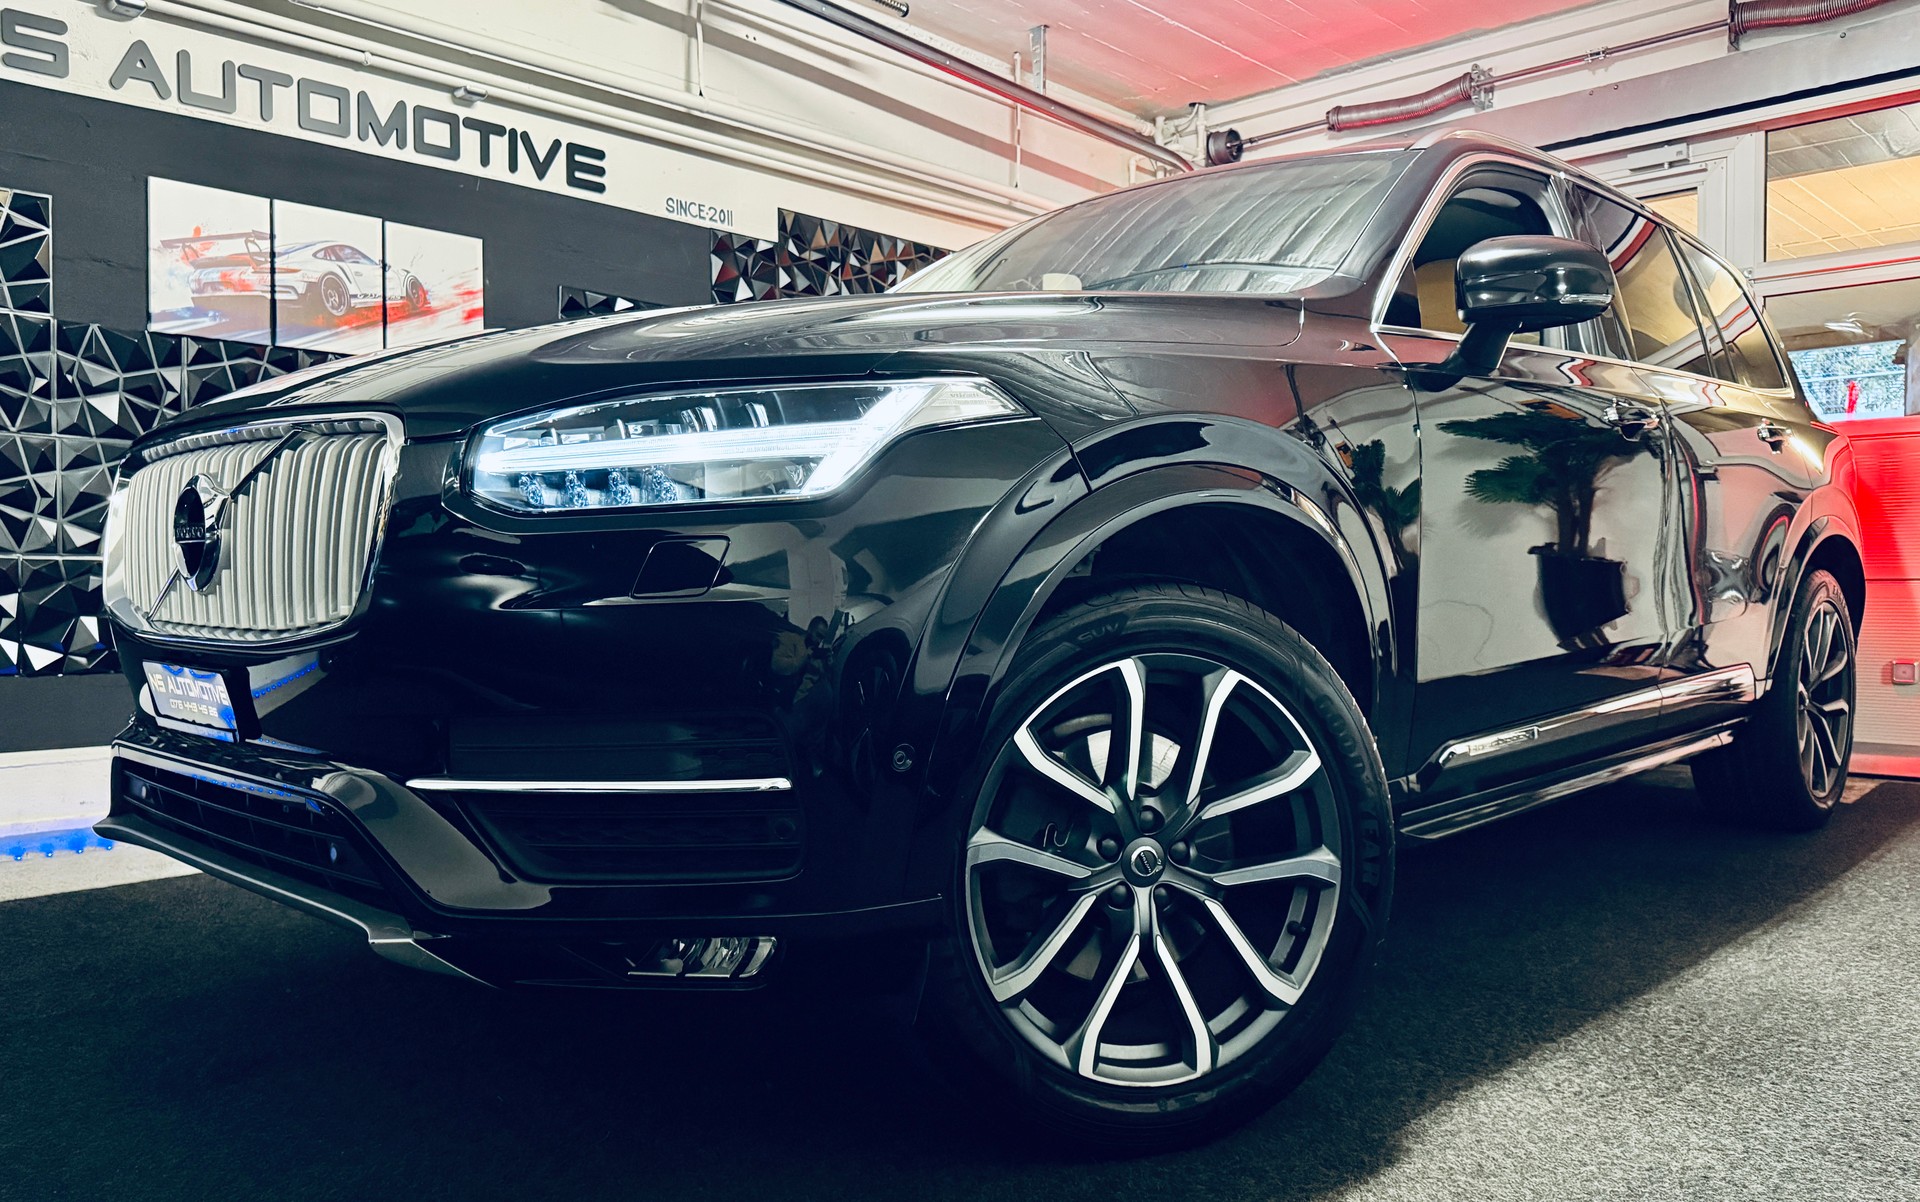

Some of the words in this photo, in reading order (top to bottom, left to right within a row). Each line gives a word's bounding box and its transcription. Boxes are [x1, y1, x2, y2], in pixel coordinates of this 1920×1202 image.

[109, 39, 607, 194] AUTOMOTIVE
[1077, 623, 1119, 641] SUV
[148, 672, 167, 693] NS
[168, 675, 230, 706] AUTOMOTIVE
